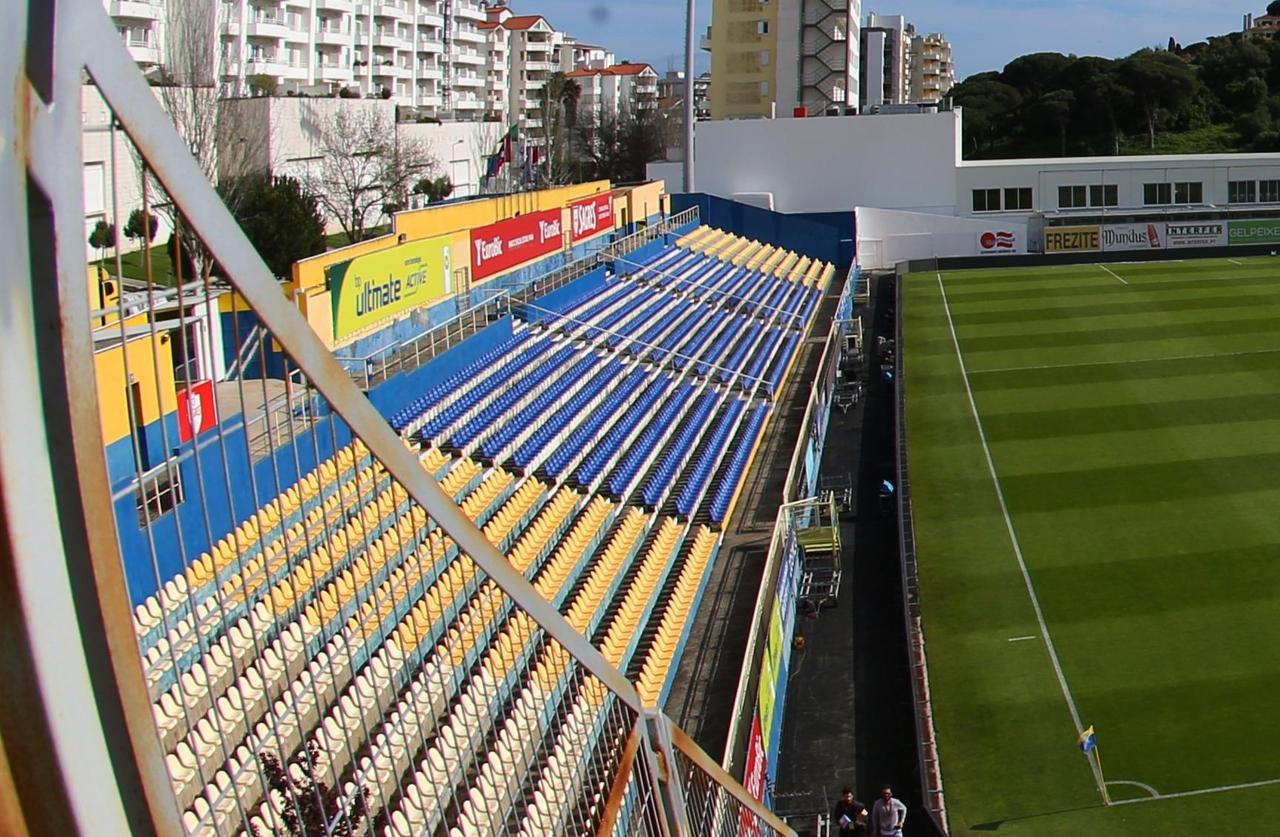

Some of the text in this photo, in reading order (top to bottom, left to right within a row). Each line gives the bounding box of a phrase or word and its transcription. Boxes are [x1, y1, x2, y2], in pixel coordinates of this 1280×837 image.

[1045, 231, 1098, 249] FREZITE
[1102, 229, 1148, 248] Mundus
[1229, 226, 1280, 237] GELPEIXE
[356, 273, 401, 316] ultimate
